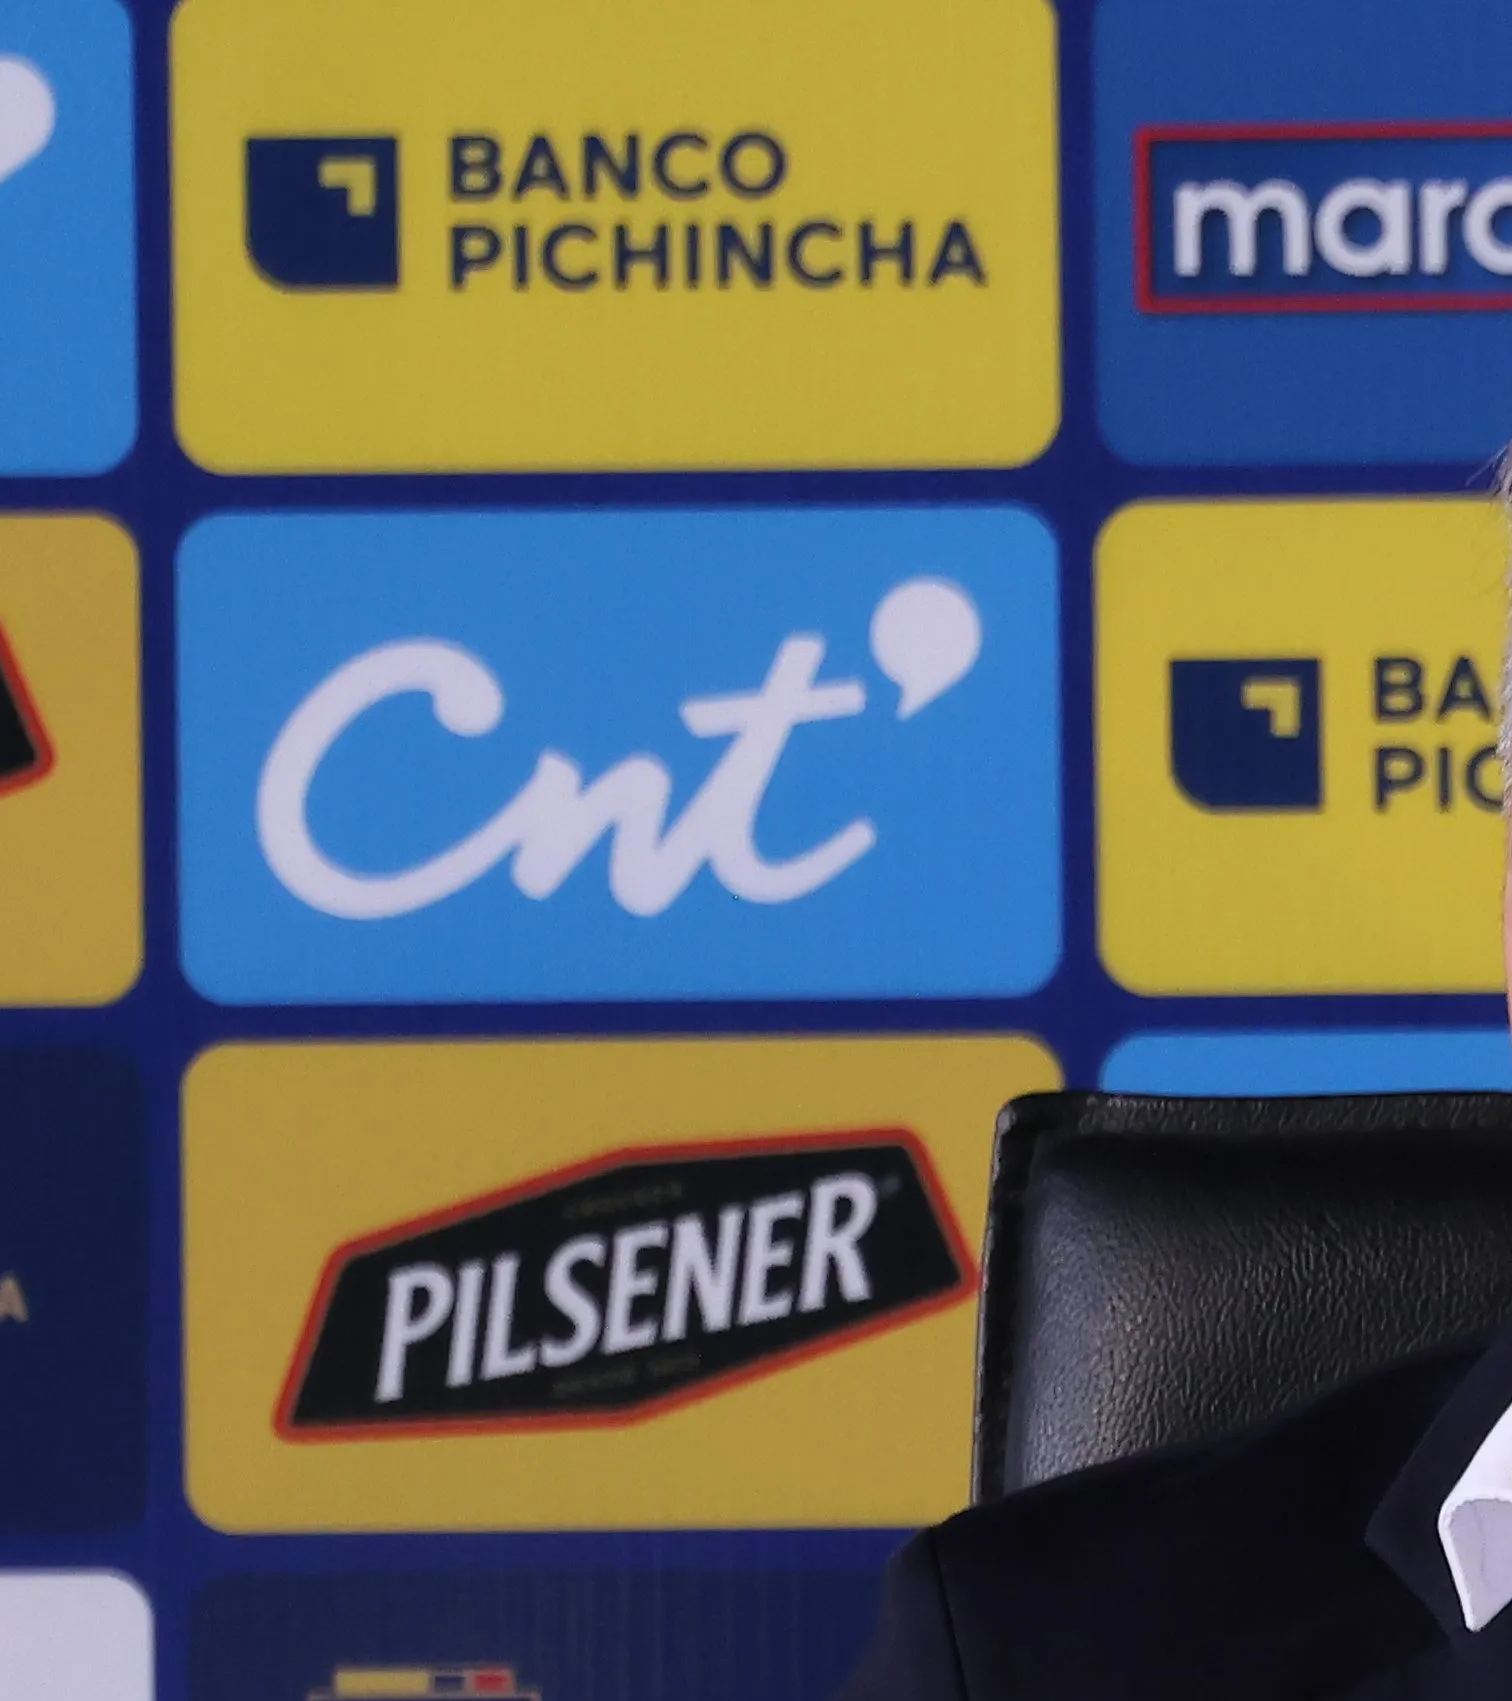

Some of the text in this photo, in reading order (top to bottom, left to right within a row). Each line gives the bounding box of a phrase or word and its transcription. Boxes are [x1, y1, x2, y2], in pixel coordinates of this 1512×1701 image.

[448, 131, 786, 200] BANCO
[448, 220, 988, 291] PICHINCHA
[374, 1172, 877, 1403] PILSENER
